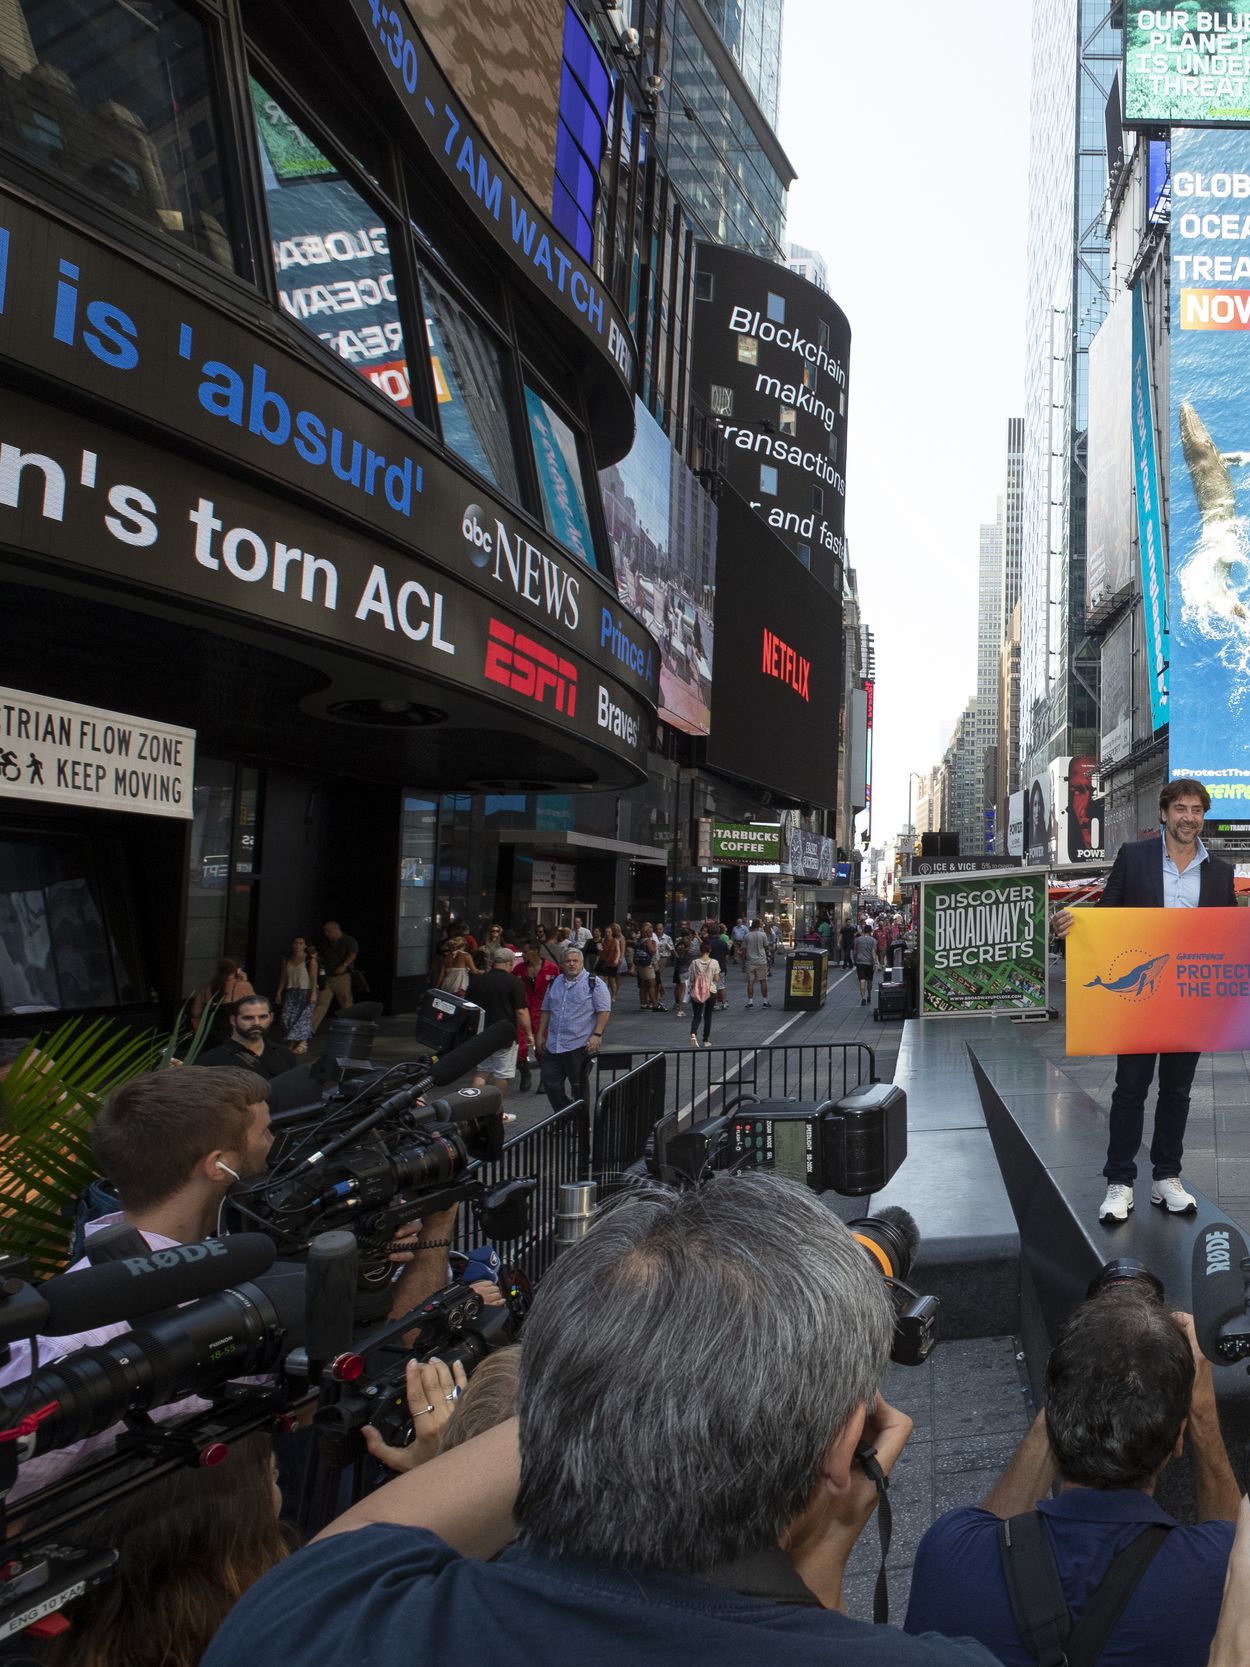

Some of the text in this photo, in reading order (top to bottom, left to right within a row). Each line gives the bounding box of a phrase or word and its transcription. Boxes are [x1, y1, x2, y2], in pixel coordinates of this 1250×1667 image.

[1137, 10, 1189, 31] OUR
[1149, 32, 1247, 54] PLANET
[1136, 53, 1168, 75] IS
[1149, 76, 1247, 97] THREAT
[511, 195, 604, 334] WATCH
[729, 306, 845, 389] Blockchain
[53, 257, 139, 370] is
[179, 322, 423, 517] 'absurd'
[755, 372, 835, 431] making
[768, 505, 814, 538] and
[189, 497, 338, 610] torn
[355, 565, 455, 654] ACL
[462, 517, 580, 630] abc NEWS
[600, 607, 644, 675] Prince
[484, 617, 578, 718] ESPN
[762, 627, 811, 703] NETFLIX
[0, 703, 184, 767] TRIAN FLOW ZONE
[57, 758, 182, 804] KEEP MOVING
[720, 842, 765, 853] COFFEE
[933, 863, 946, 871] ICE
[949, 863, 956, 871] &
[958, 862, 977, 871] VICE
[935, 885, 1034, 910] DISCOVER
[935, 900, 1034, 951] BROADWAY'S
[934, 941, 1034, 969] SECRETS
[1176, 953, 1225, 961] GREENPEACE
[1177, 982, 1212, 998] THE
[805, 1124, 813, 1151] SPEEDLIGHT
[122, 1238, 228, 1277] RØDE
[1206, 1231, 1230, 1276] RØDE
[208, 1334, 233, 1350] FUJINON
[9, 1608, 39, 1631] ENG
[42, 1599, 57, 1611] 10
